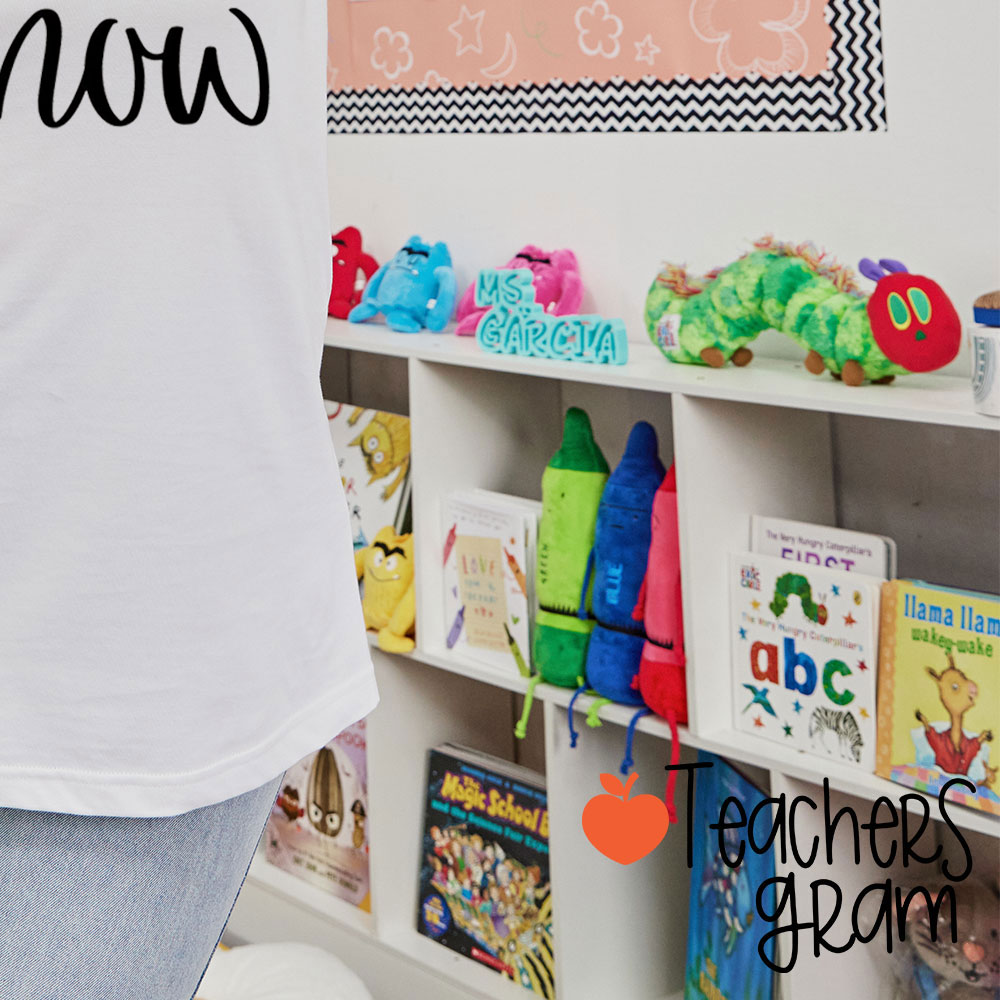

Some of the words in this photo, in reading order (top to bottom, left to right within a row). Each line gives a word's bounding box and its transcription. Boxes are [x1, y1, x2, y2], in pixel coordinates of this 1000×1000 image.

[480, 313, 617, 363] GARCIA
[767, 529, 778, 540] The
[904, 593, 954, 628] llama
[911, 627, 993, 657] wakey-wake
[750, 636, 856, 706] abc
[441, 772, 488, 811] Magic
[486, 788, 541, 832] School
